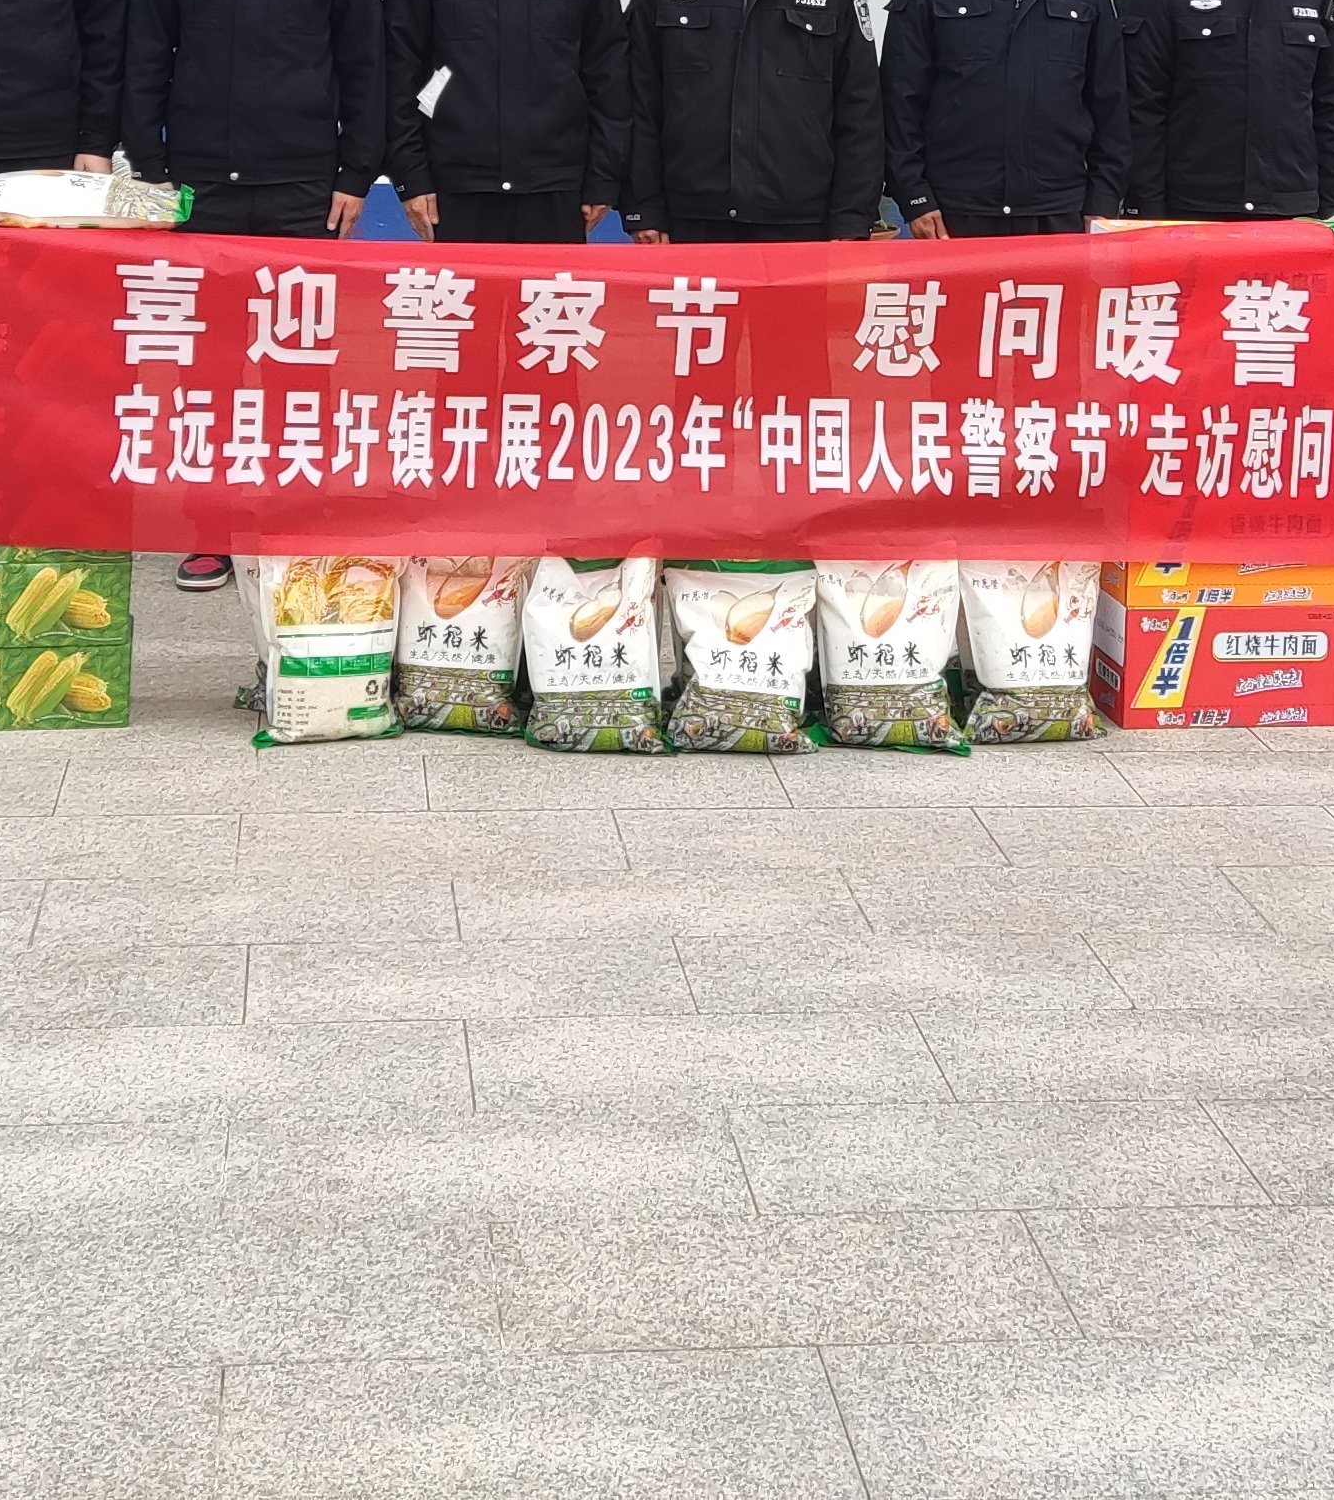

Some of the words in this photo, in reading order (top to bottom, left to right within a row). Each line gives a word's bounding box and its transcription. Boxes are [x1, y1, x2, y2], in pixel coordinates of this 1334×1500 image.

[113, 259, 739, 377] 喜迎警察节
[416, 620, 490, 651] 虾稻米
[1225, 634, 1318, 657] 红烧牛肉面
[408, 649, 497, 665] 生态/天然/健康
[554, 641, 629, 670] 虾稻米
[709, 647, 784, 677] 虾稻米
[847, 640, 922, 668] 虾稻米
[1009, 642, 1080, 669] 虾稻米
[1150, 617, 1195, 698] 1倍半
